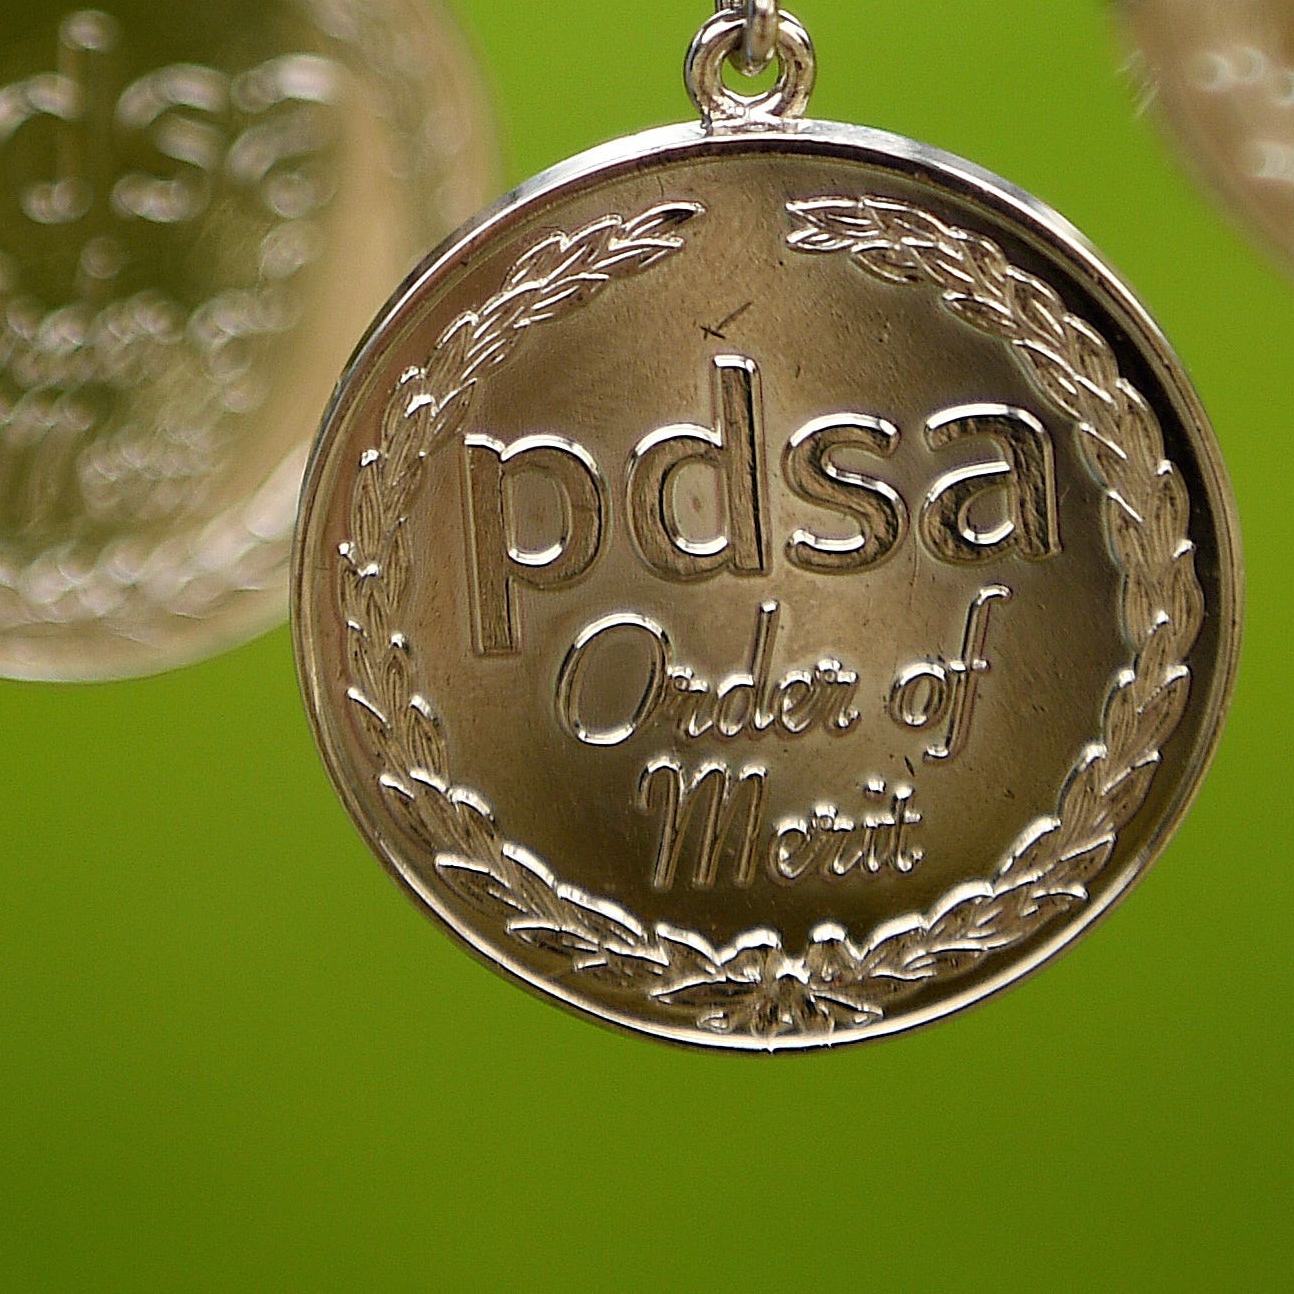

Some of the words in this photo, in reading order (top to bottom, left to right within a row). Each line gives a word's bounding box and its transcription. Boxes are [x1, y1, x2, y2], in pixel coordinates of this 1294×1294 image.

[463, 354, 1064, 654] pdsa
[555, 600, 861, 746] Order
[888, 584, 1011, 762] of
[637, 756, 927, 892] Merit
